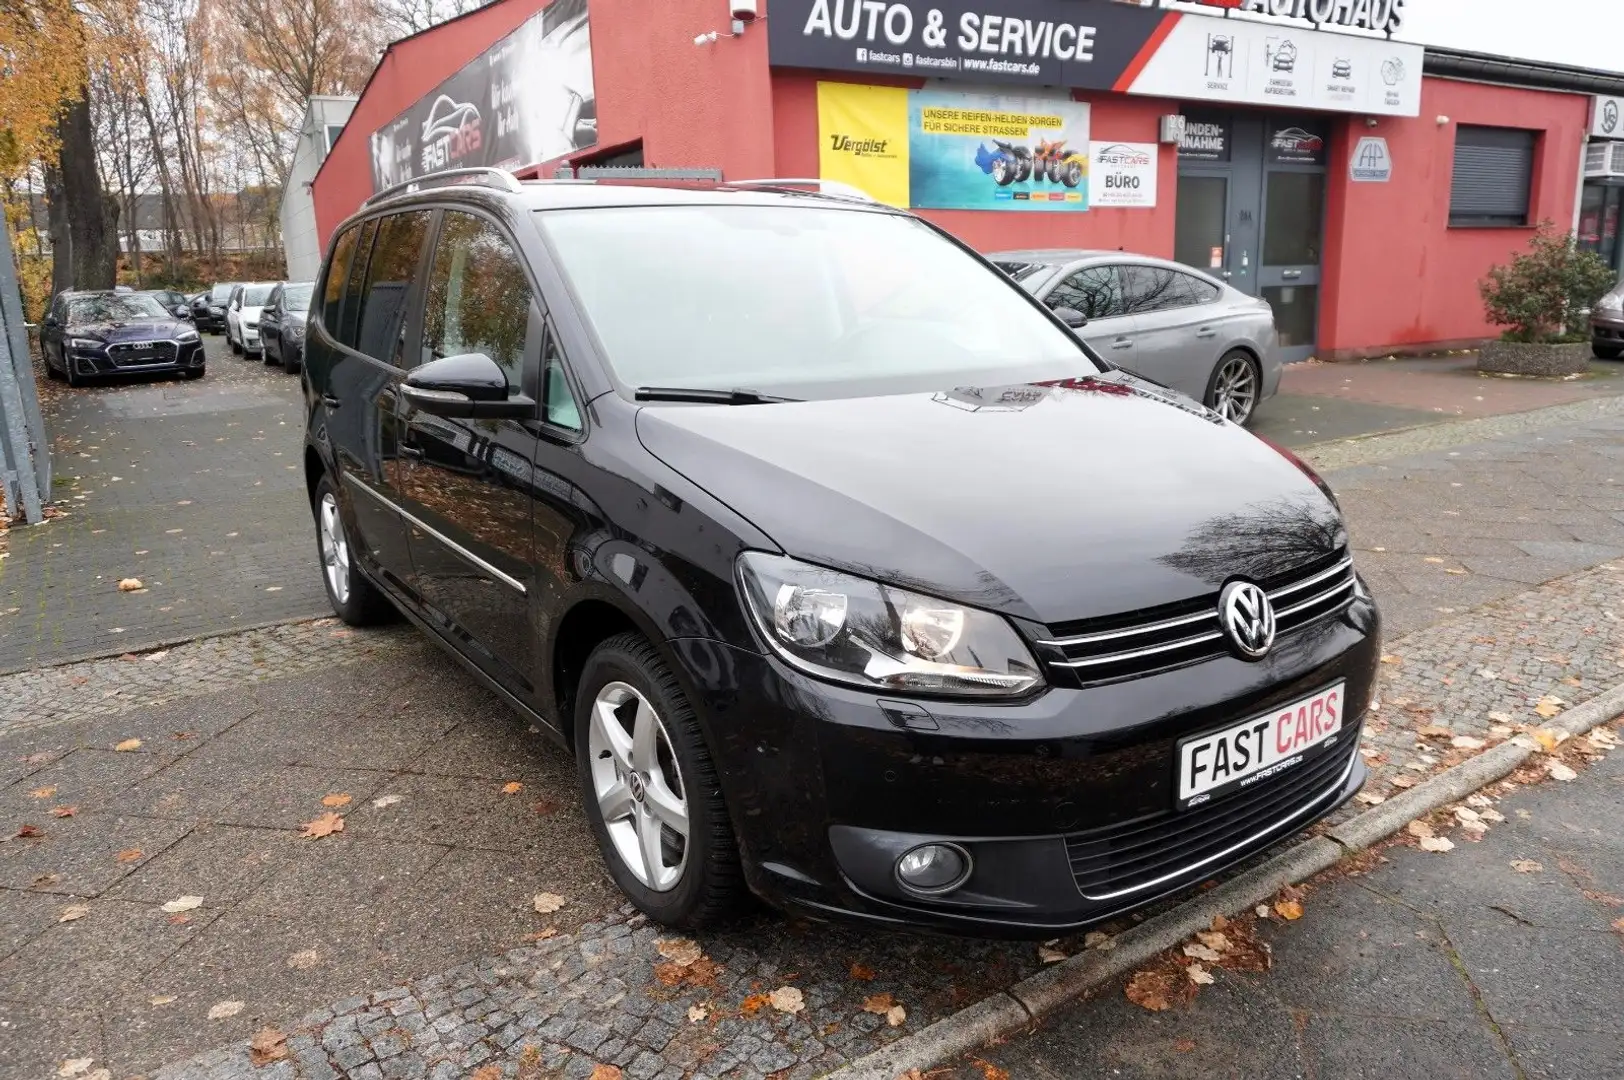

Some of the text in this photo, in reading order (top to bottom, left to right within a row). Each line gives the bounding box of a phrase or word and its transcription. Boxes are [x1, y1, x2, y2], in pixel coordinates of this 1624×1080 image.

[804, 0, 1097, 61] AUTO & SERVICE
[868, 49, 900, 63] fastcars
[964, 57, 1041, 75] www.fastcars.de
[923, 109, 1062, 127] UNSERE REIFEN-HELDEN SORGEN
[923, 121, 1028, 136] FÜR SICHERE STRASSEN!
[1184, 121, 1224, 137] UNDEN-
[830, 133, 888, 156] Vergölst
[1105, 171, 1141, 189] BÜRO
[1190, 691, 1338, 790] FAST CARS
